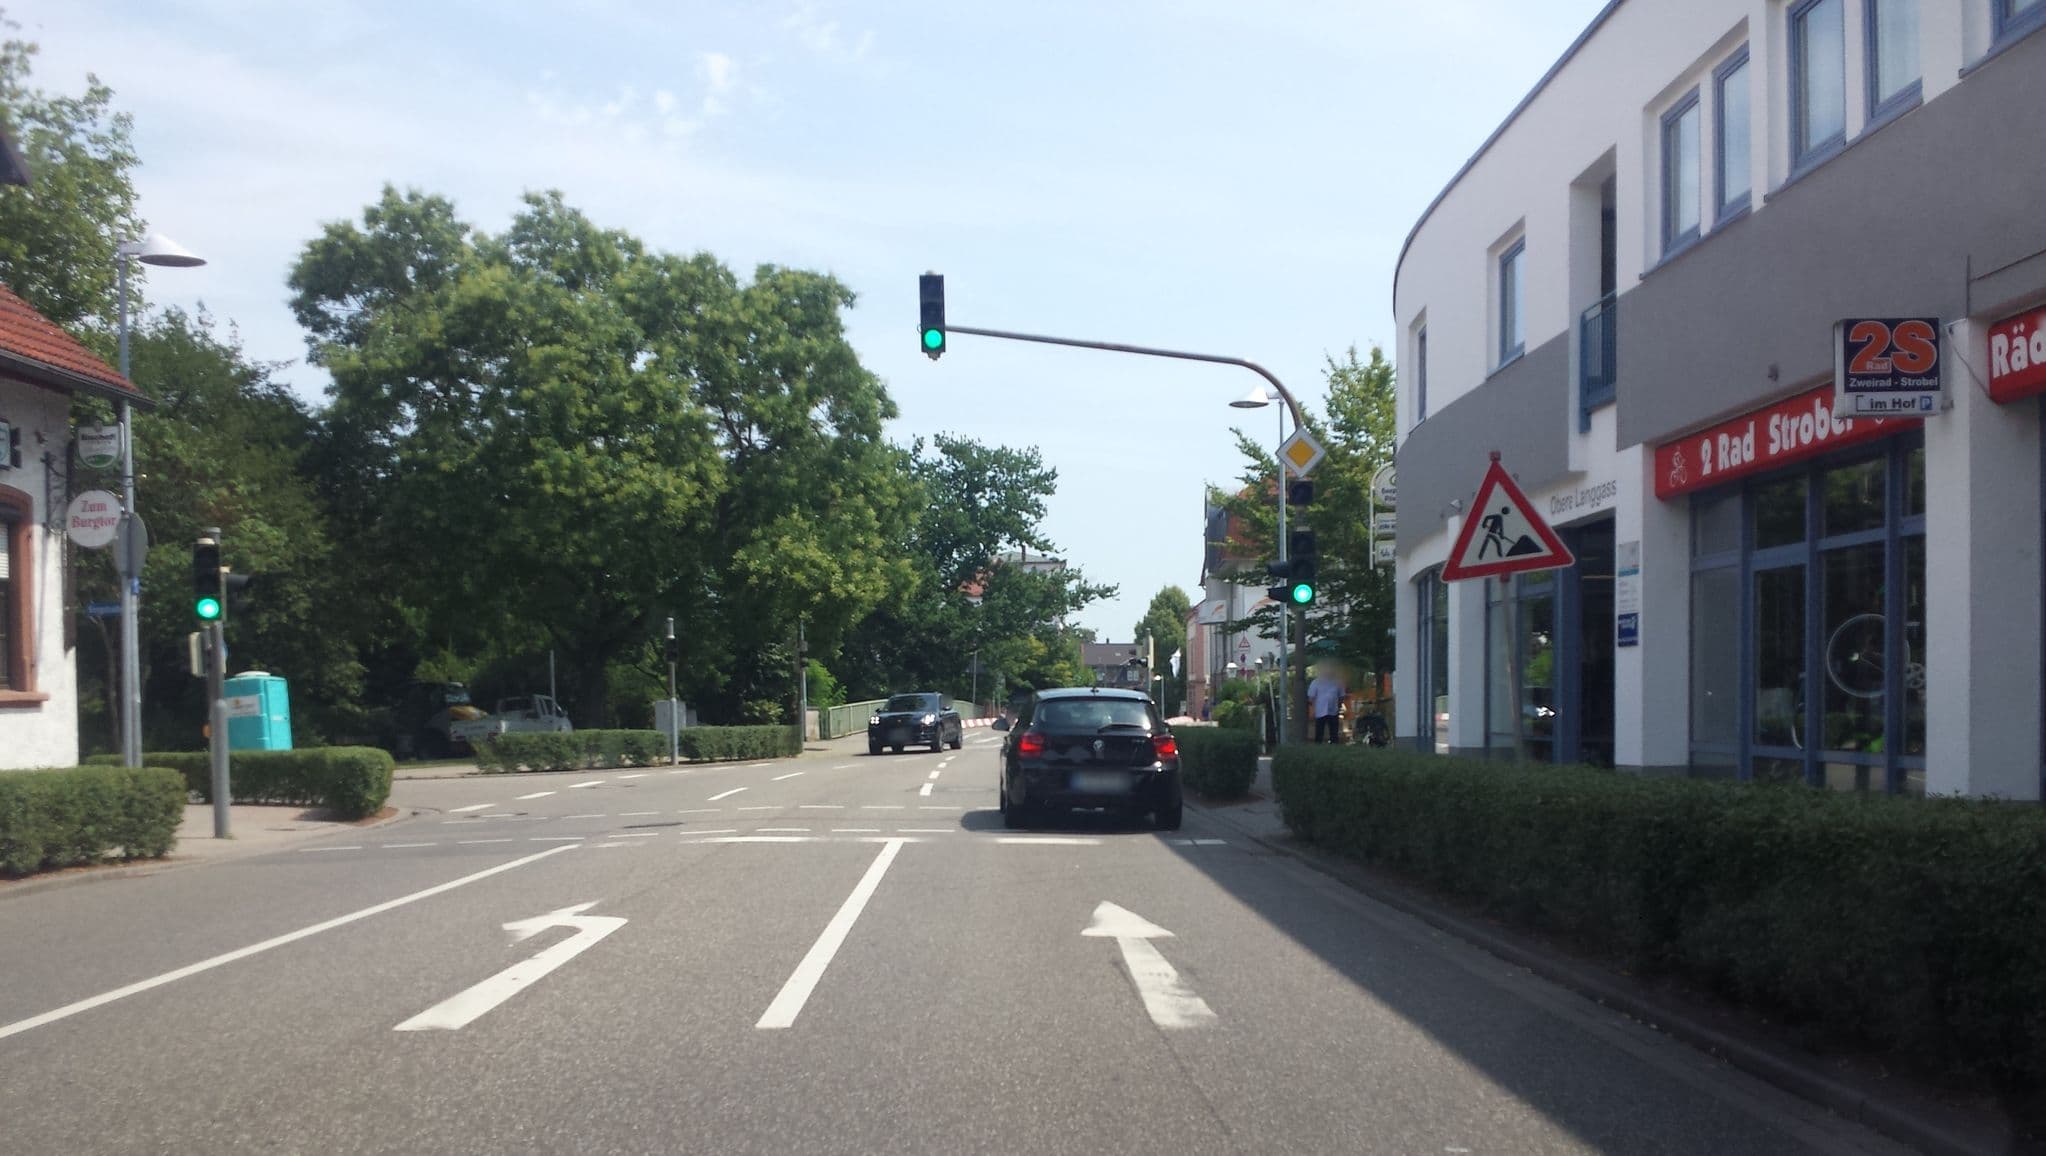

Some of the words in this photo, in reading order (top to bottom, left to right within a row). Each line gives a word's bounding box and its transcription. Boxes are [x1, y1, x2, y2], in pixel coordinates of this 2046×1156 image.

[1849, 320, 1938, 374] 2S
[1866, 360, 1889, 371] Rad
[1849, 377, 1892, 388] Zweirad
[1900, 376, 1938, 387] Strobel
[1870, 398, 1888, 409] im
[1892, 398, 1917, 409] Hof
[1702, 438, 1713, 477] 2
[1718, 421, 1755, 471] Rad
[79, 500, 107, 513] Zum
[71, 515, 117, 530] Burgtor
